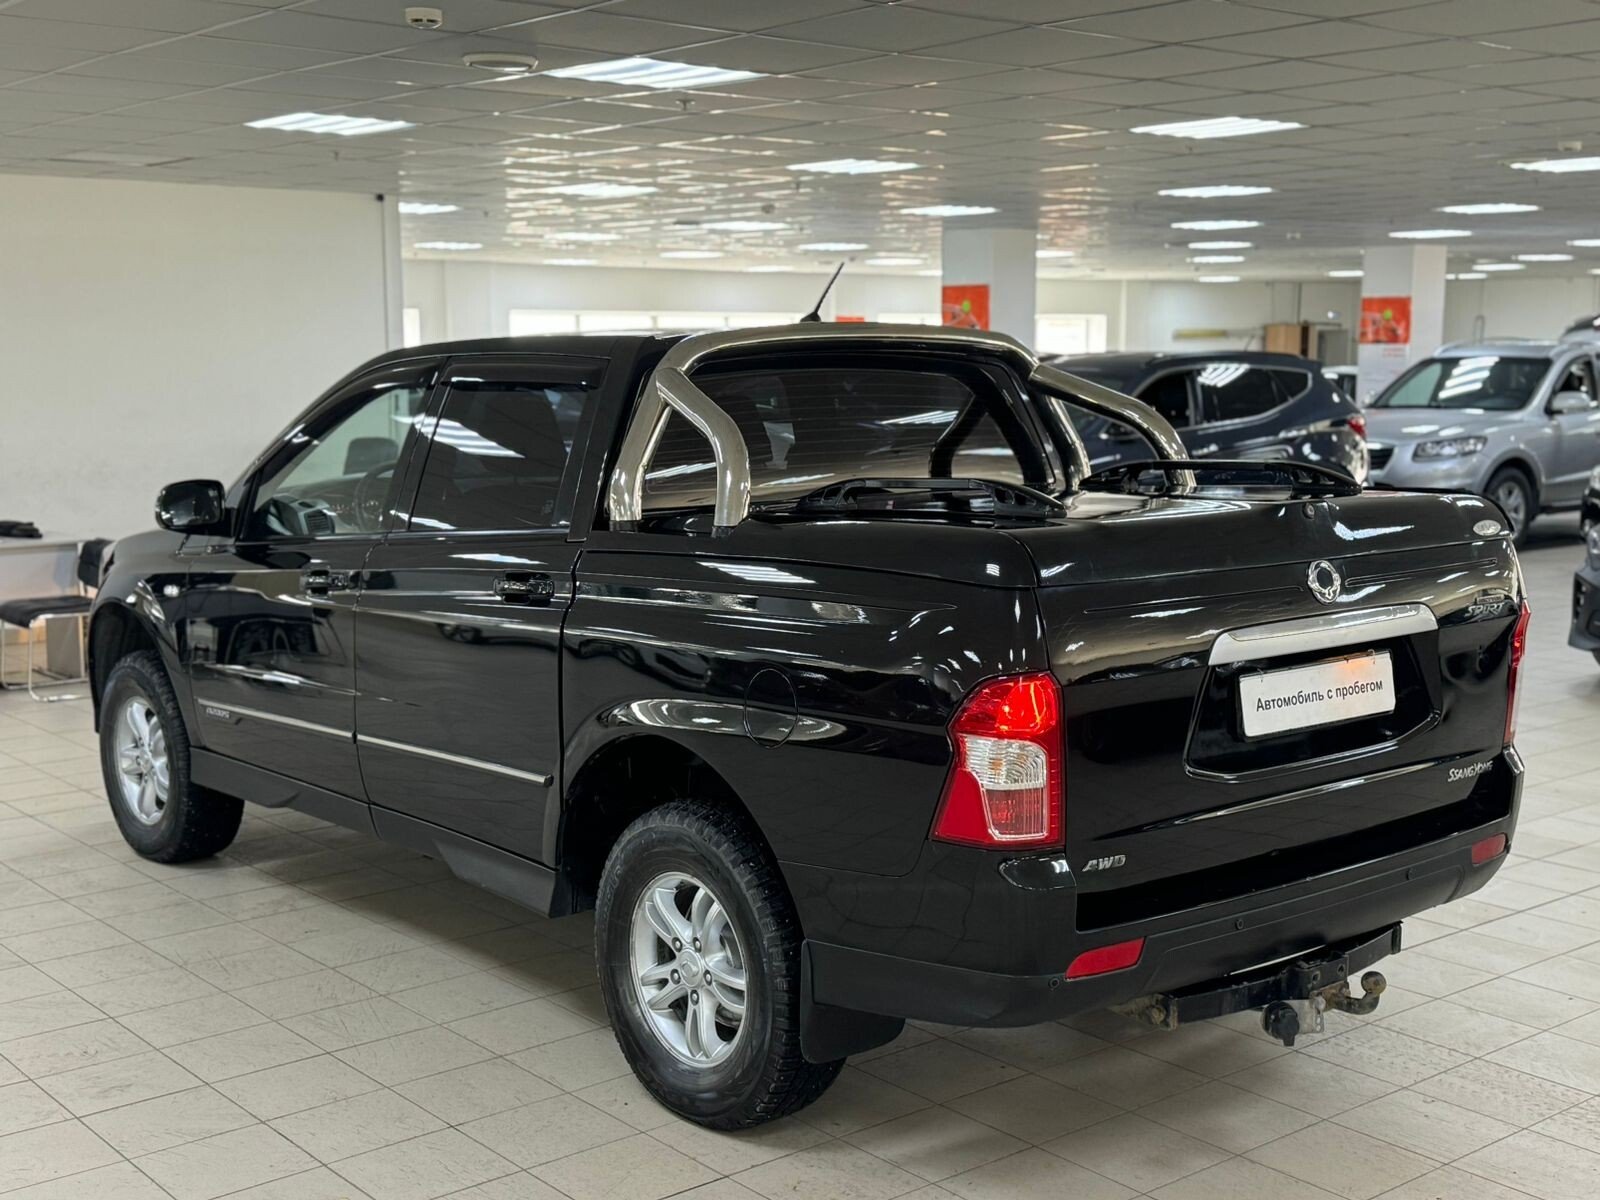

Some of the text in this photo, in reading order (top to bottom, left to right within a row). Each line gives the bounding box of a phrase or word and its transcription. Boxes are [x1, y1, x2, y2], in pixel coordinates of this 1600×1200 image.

[1256, 679, 1383, 712] Автомобиль с пробегом
[1082, 854, 1126, 872] AWD
